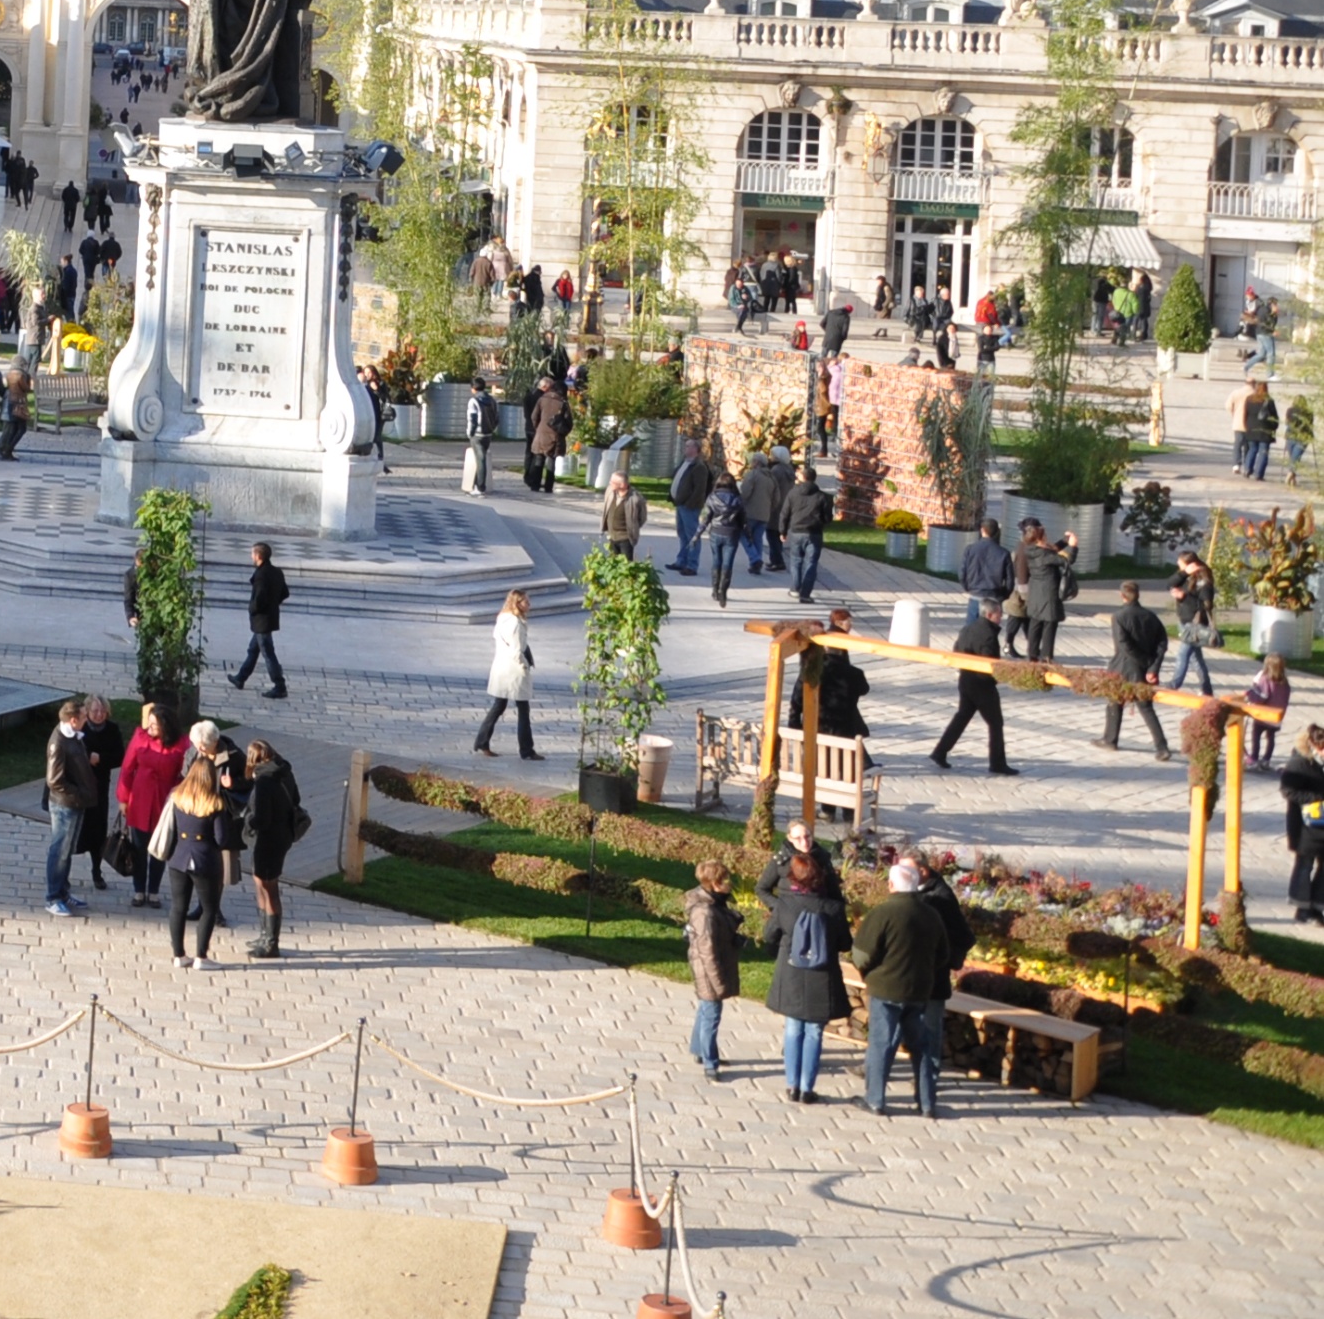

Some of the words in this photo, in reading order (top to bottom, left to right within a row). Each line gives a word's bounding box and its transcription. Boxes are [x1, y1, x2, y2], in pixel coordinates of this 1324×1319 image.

[765, 196, 801, 207] DAUM
[919, 203, 956, 214] DAUM
[206, 242, 293, 256] STANISLAS
[202, 263, 296, 277] LESZCZYNSKI
[200, 283, 219, 292] ROI
[224, 285, 238, 293] DE
[244, 286, 295, 296] POLOGNE
[233, 304, 260, 314] DUC
[205, 322, 220, 331] DE
[226, 324, 287, 334] LORRAINE
[235, 343, 255, 353] ET
[217, 362, 235, 372] DE
[241, 363, 270, 374] BAR
[213, 388, 237, 397] 1737
[249, 389, 271, 398] 1766
